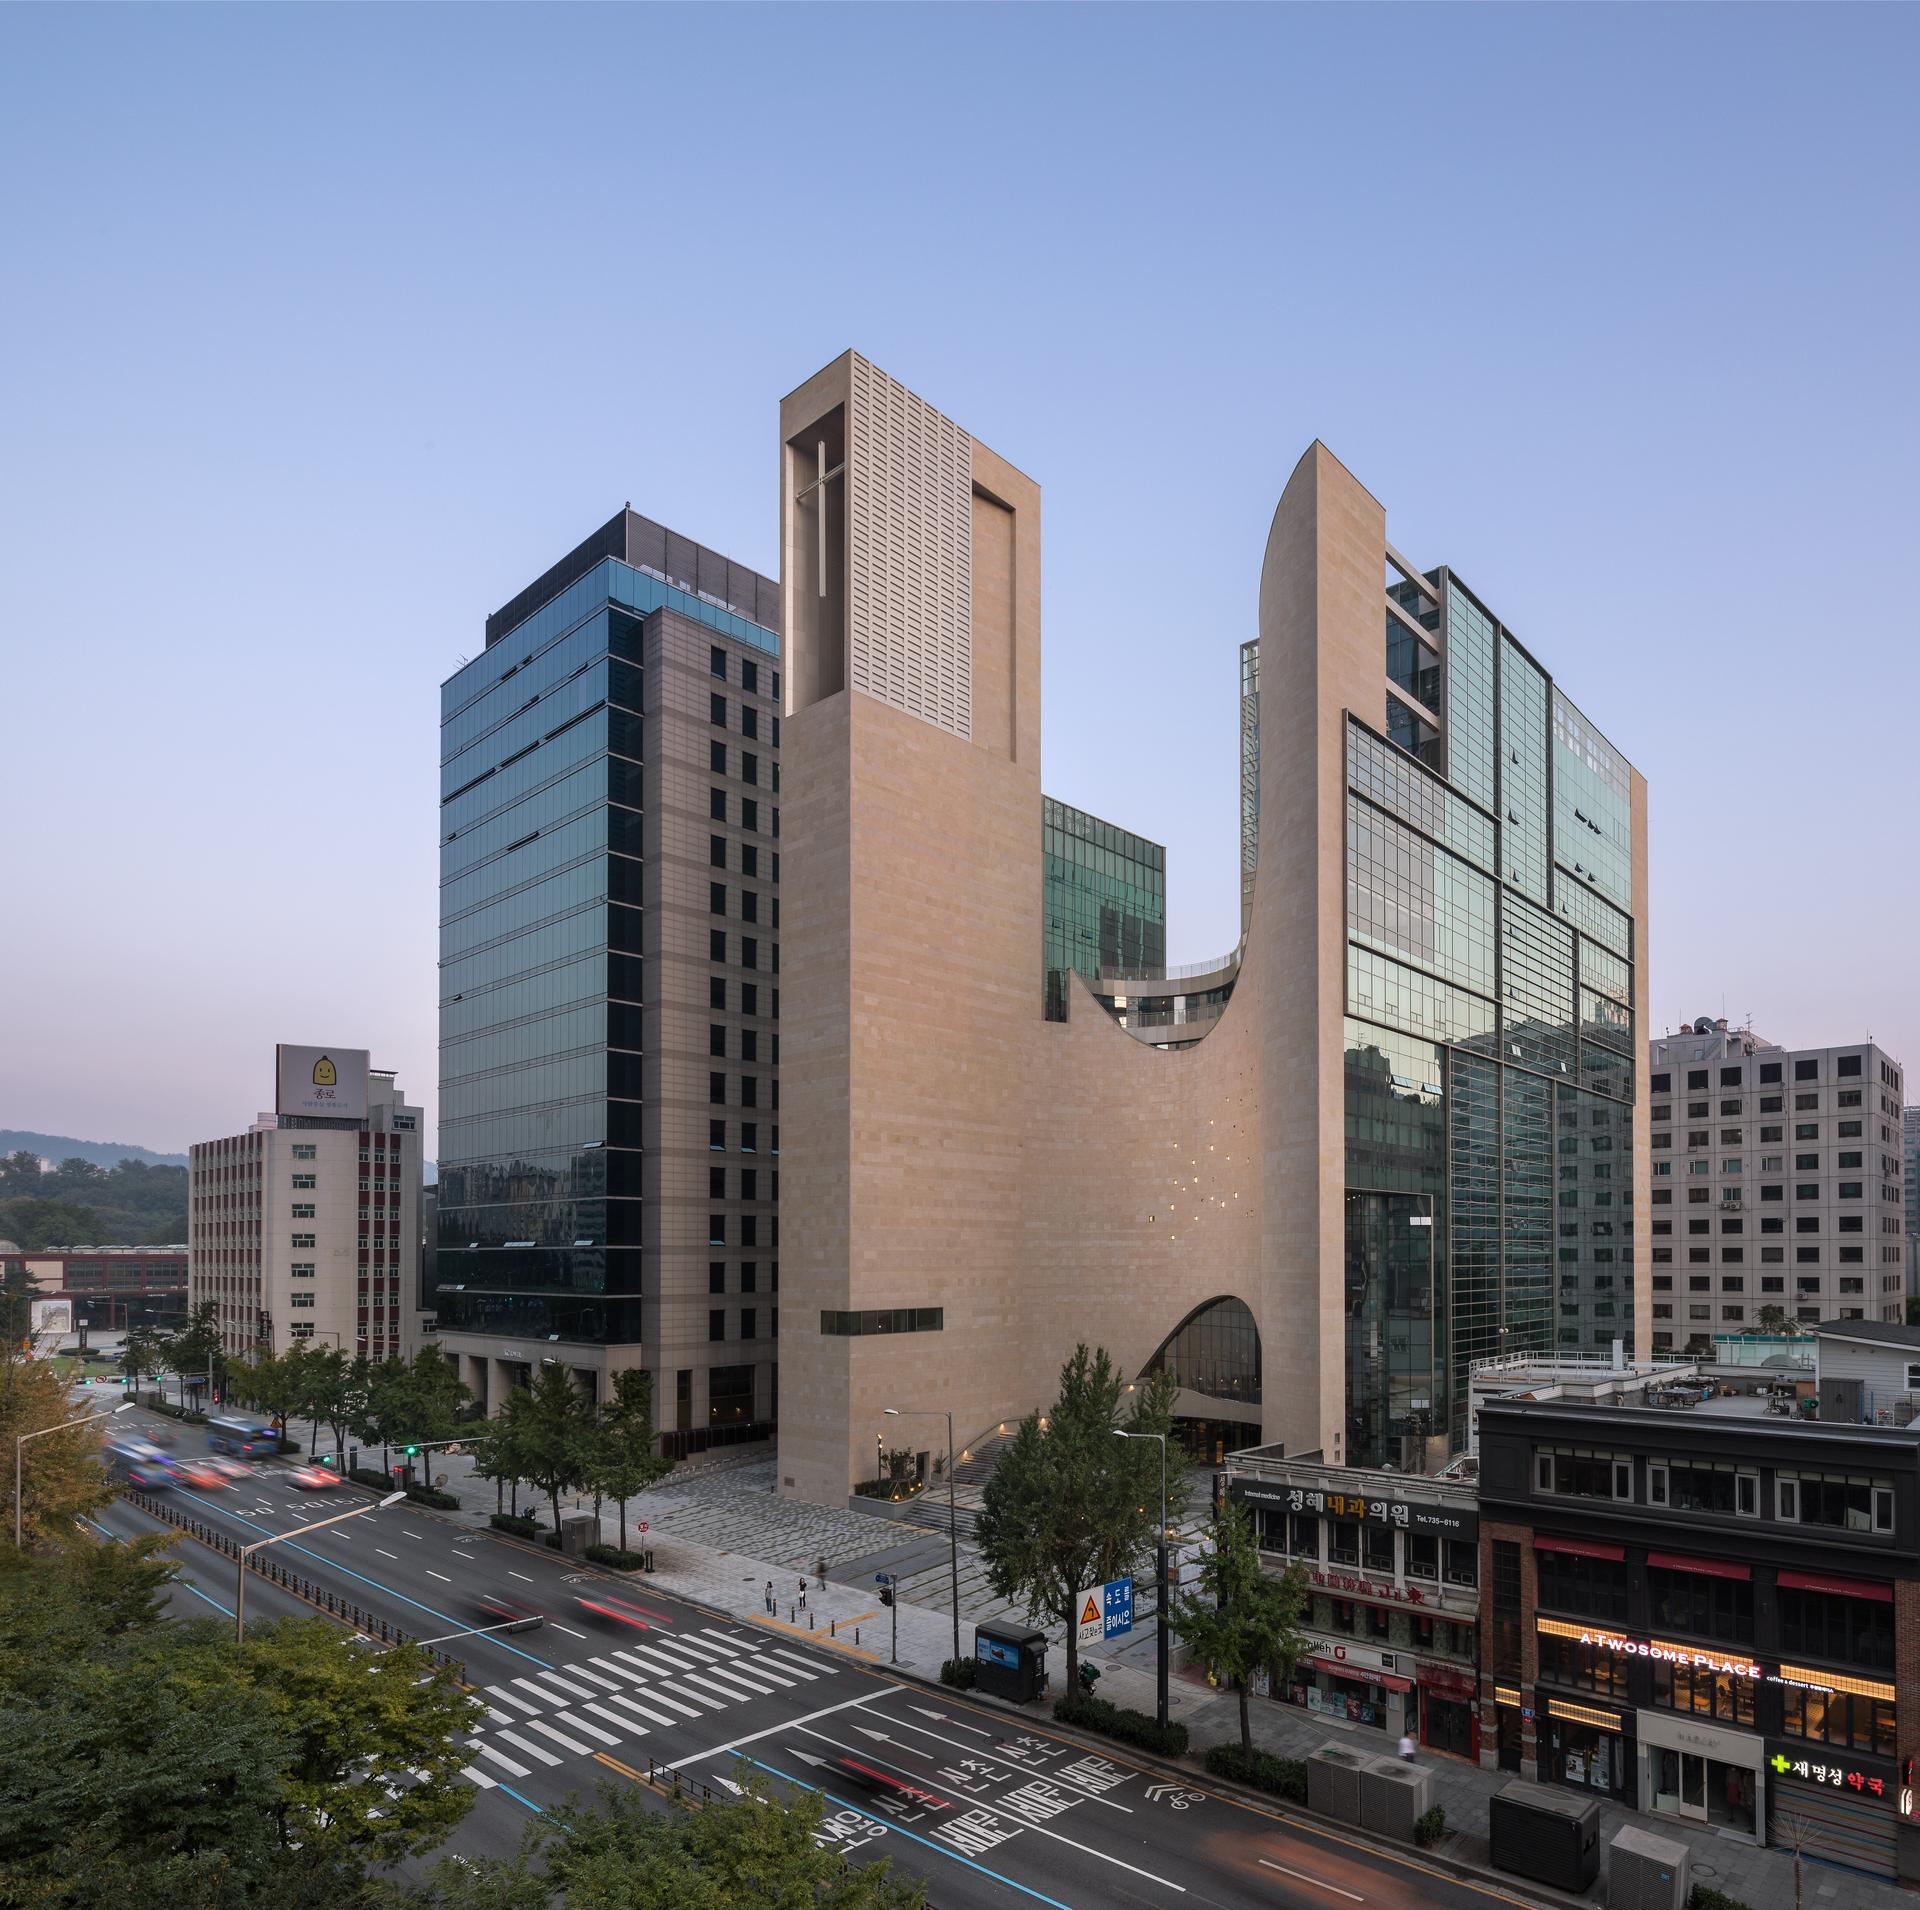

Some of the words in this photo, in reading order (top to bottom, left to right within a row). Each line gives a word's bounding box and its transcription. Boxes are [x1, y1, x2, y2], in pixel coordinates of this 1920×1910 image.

[313, 1088, 336, 1100] 종로
[286, 1500, 324, 1512] 50
[334, 1496, 371, 1506] 50
[1244, 1489, 1260, 1498] Internal
[1260, 1492, 1281, 1501] medicine
[235, 1507, 275, 1518] 50
[1105, 1585, 1131, 1606] 속도를
[1105, 1609, 1131, 1632] 줄이시오
[1766, 1675, 1784, 1684] coffee
[1788, 1680, 1809, 1689] dessert
[995, 1736, 1068, 1766] 신촌
[936, 1759, 1012, 1793] 신촌
[1053, 1755, 1139, 1795] 서대문
[1792, 1761, 1842, 1786] 새명성
[1847, 1771, 1885, 1797] 약국
[995, 1780, 1085, 1824] 서대문
[929, 1808, 1025, 1858] 서대문
